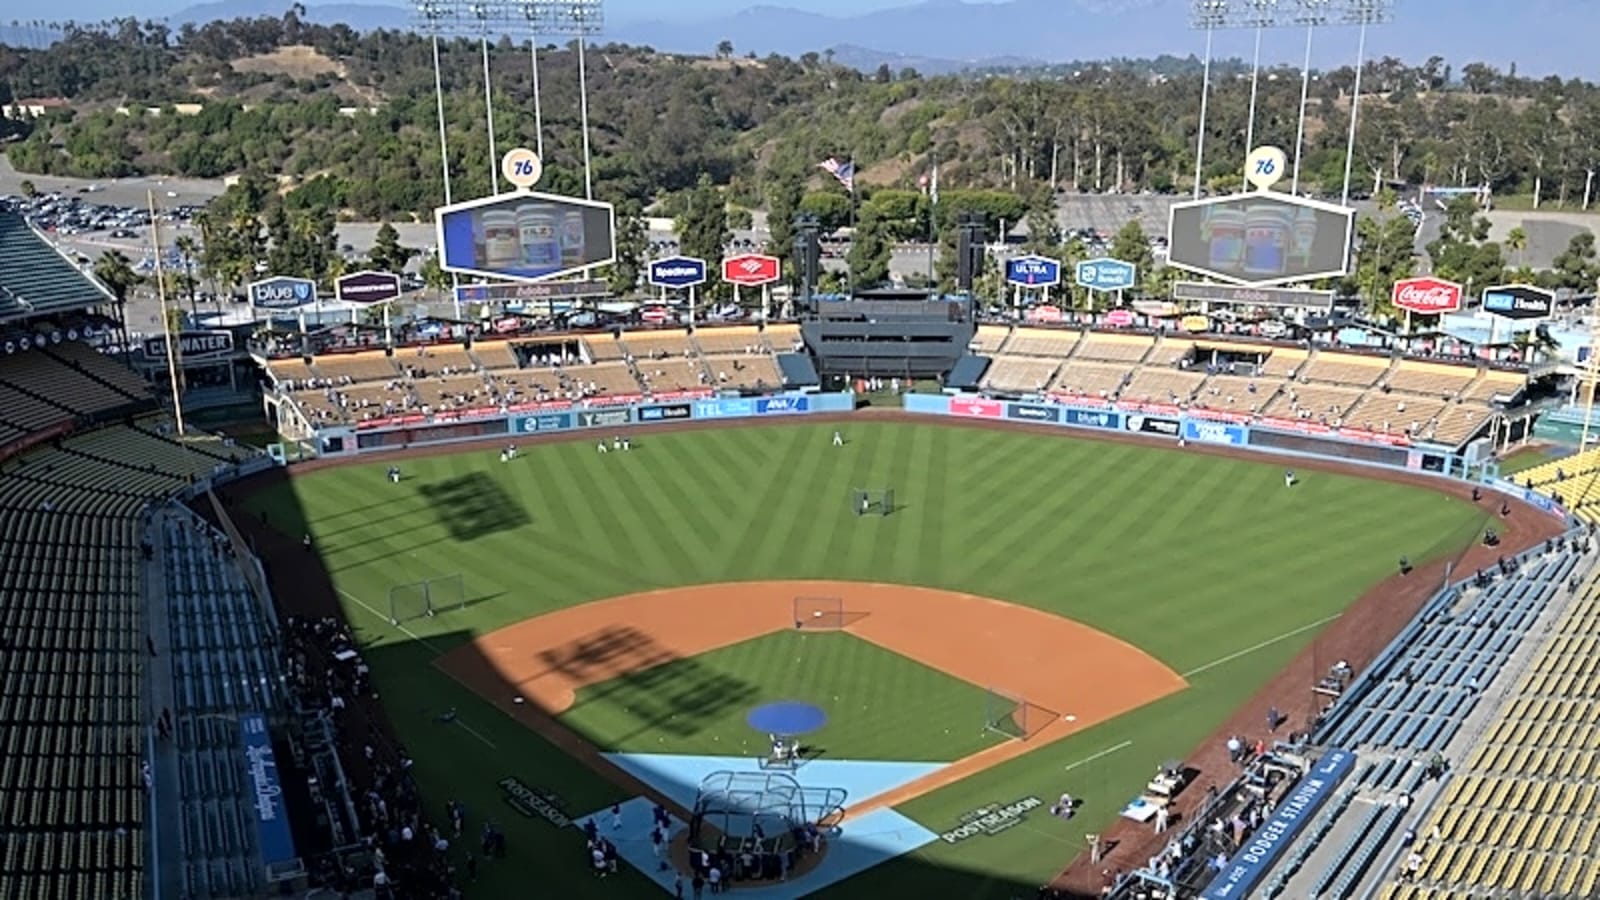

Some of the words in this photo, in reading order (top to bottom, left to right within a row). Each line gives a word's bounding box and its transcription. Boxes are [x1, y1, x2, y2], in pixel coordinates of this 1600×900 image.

[515, 160, 533, 175] 76
[1256, 158, 1275, 174] 76
[656, 267, 698, 278] Spectrum
[1015, 264, 1047, 274] ULTRA
[257, 285, 292, 300] blue
[150, 336, 226, 355] CUWATER
[698, 403, 721, 416] TEL
[941, 797, 1042, 843] POSTSEASON
[1243, 820, 1289, 864] DODGER
[1281, 778, 1324, 819] STADIUM
